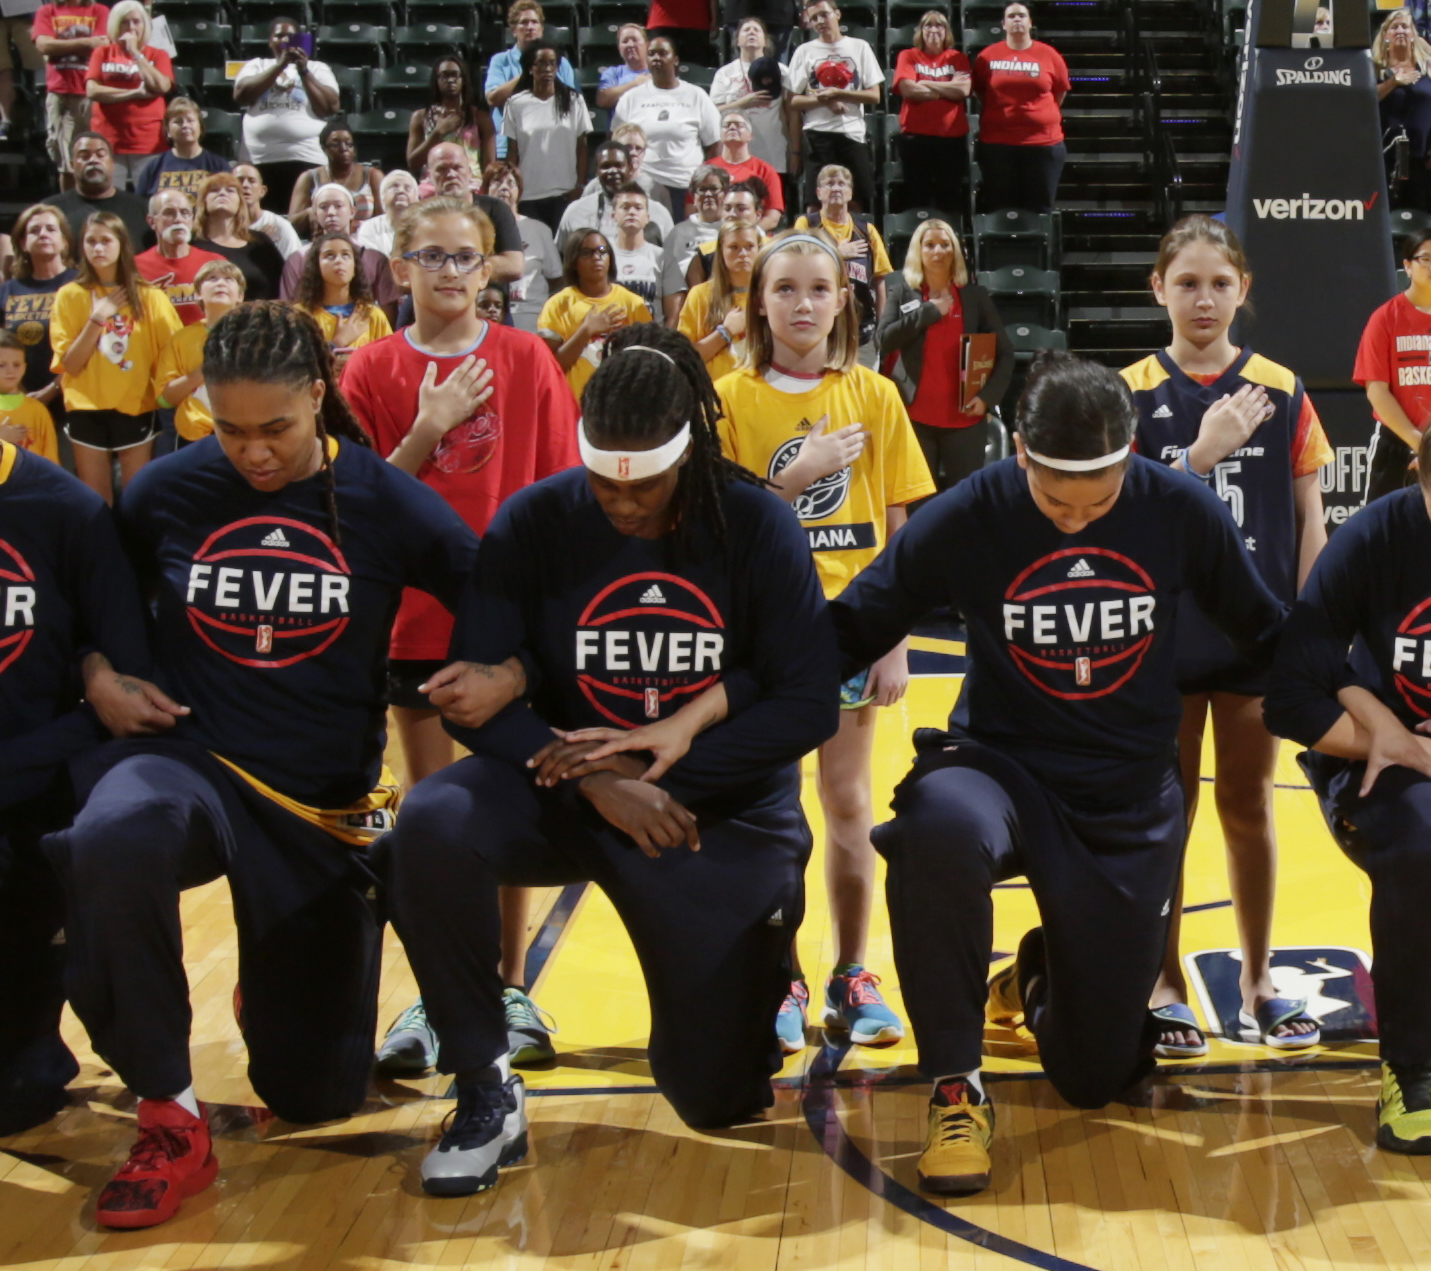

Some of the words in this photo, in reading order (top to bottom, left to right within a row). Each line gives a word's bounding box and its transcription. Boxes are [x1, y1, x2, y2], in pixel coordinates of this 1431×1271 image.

[989, 60, 1041, 73] INDIANA
[1276, 68, 1351, 86] SPALDING
[1253, 192, 1364, 221] verizon
[261, 538, 291, 548] adidas
[1066, 570, 1095, 579] adidas
[186, 563, 350, 614] FEVER
[639, 596, 667, 604] adidas
[220, 612, 313, 626] BASKETBALL
[1003, 594, 1156, 645] FEVER
[575, 630, 724, 673] FEVER
[1041, 642, 1125, 657] BASKETBALL
[612, 676, 690, 686] BASKETBALL
